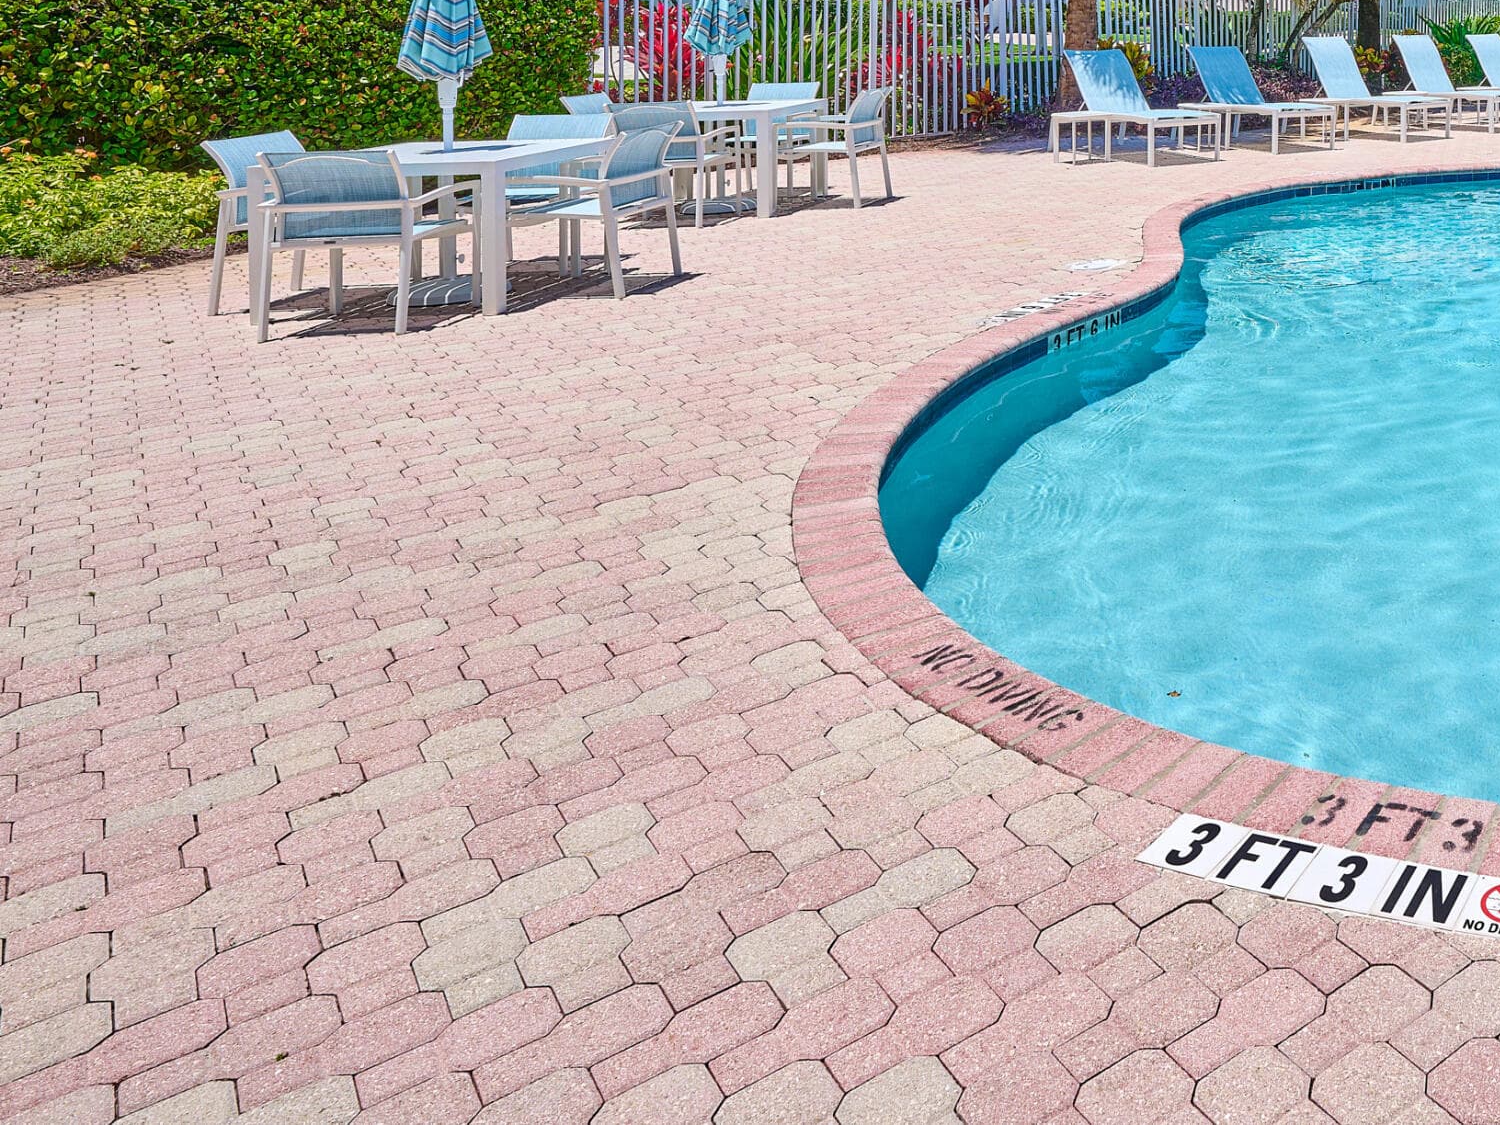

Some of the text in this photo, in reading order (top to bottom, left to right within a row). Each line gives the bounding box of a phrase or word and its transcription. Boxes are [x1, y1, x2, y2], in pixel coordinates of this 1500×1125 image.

[1054, 311, 1120, 350] 3 FT 6 IN
[911, 644, 1085, 732] NO DIVING
[1301, 793, 1346, 827] 3
[1355, 802, 1432, 843] FT
[1442, 817, 1484, 853] 3
[1164, 823, 1469, 925] 3 FT 3 IN
[1462, 918, 1485, 932] NO
